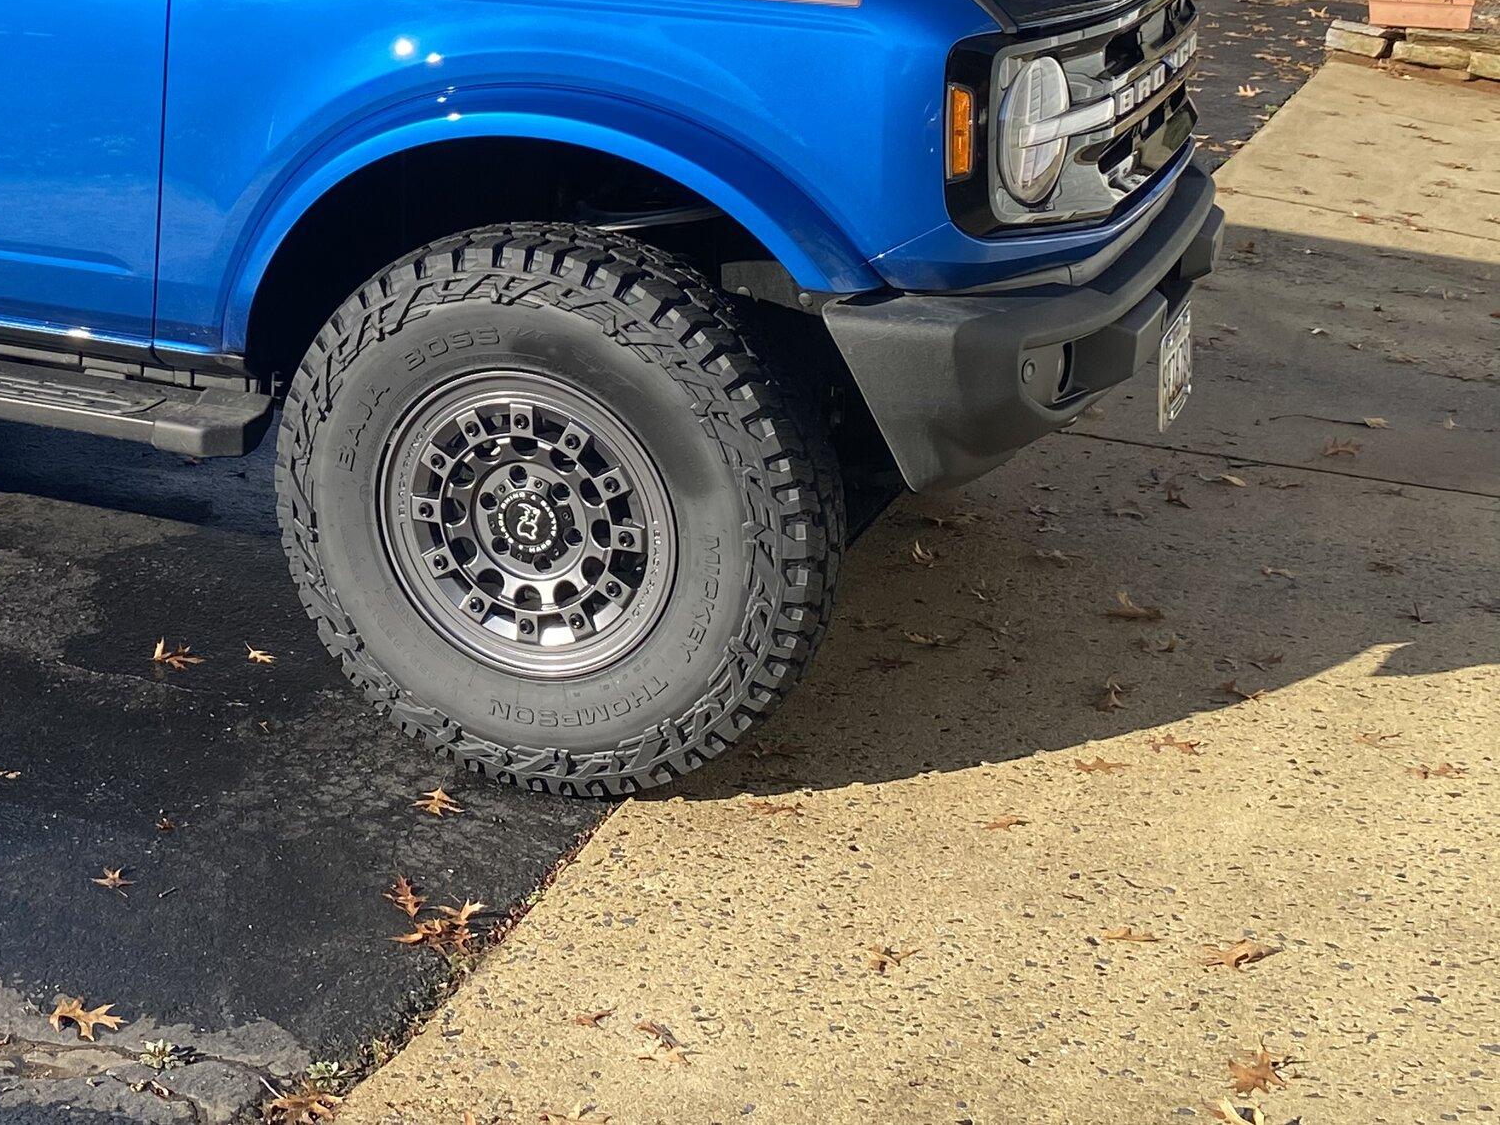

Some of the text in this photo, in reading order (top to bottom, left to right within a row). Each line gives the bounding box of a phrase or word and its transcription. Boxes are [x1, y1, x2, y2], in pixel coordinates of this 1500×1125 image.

[337, 381, 390, 472] BAJA
[403, 327, 500, 372] BOSS
[489, 535, 721, 728] MICKEY THOMPSON
